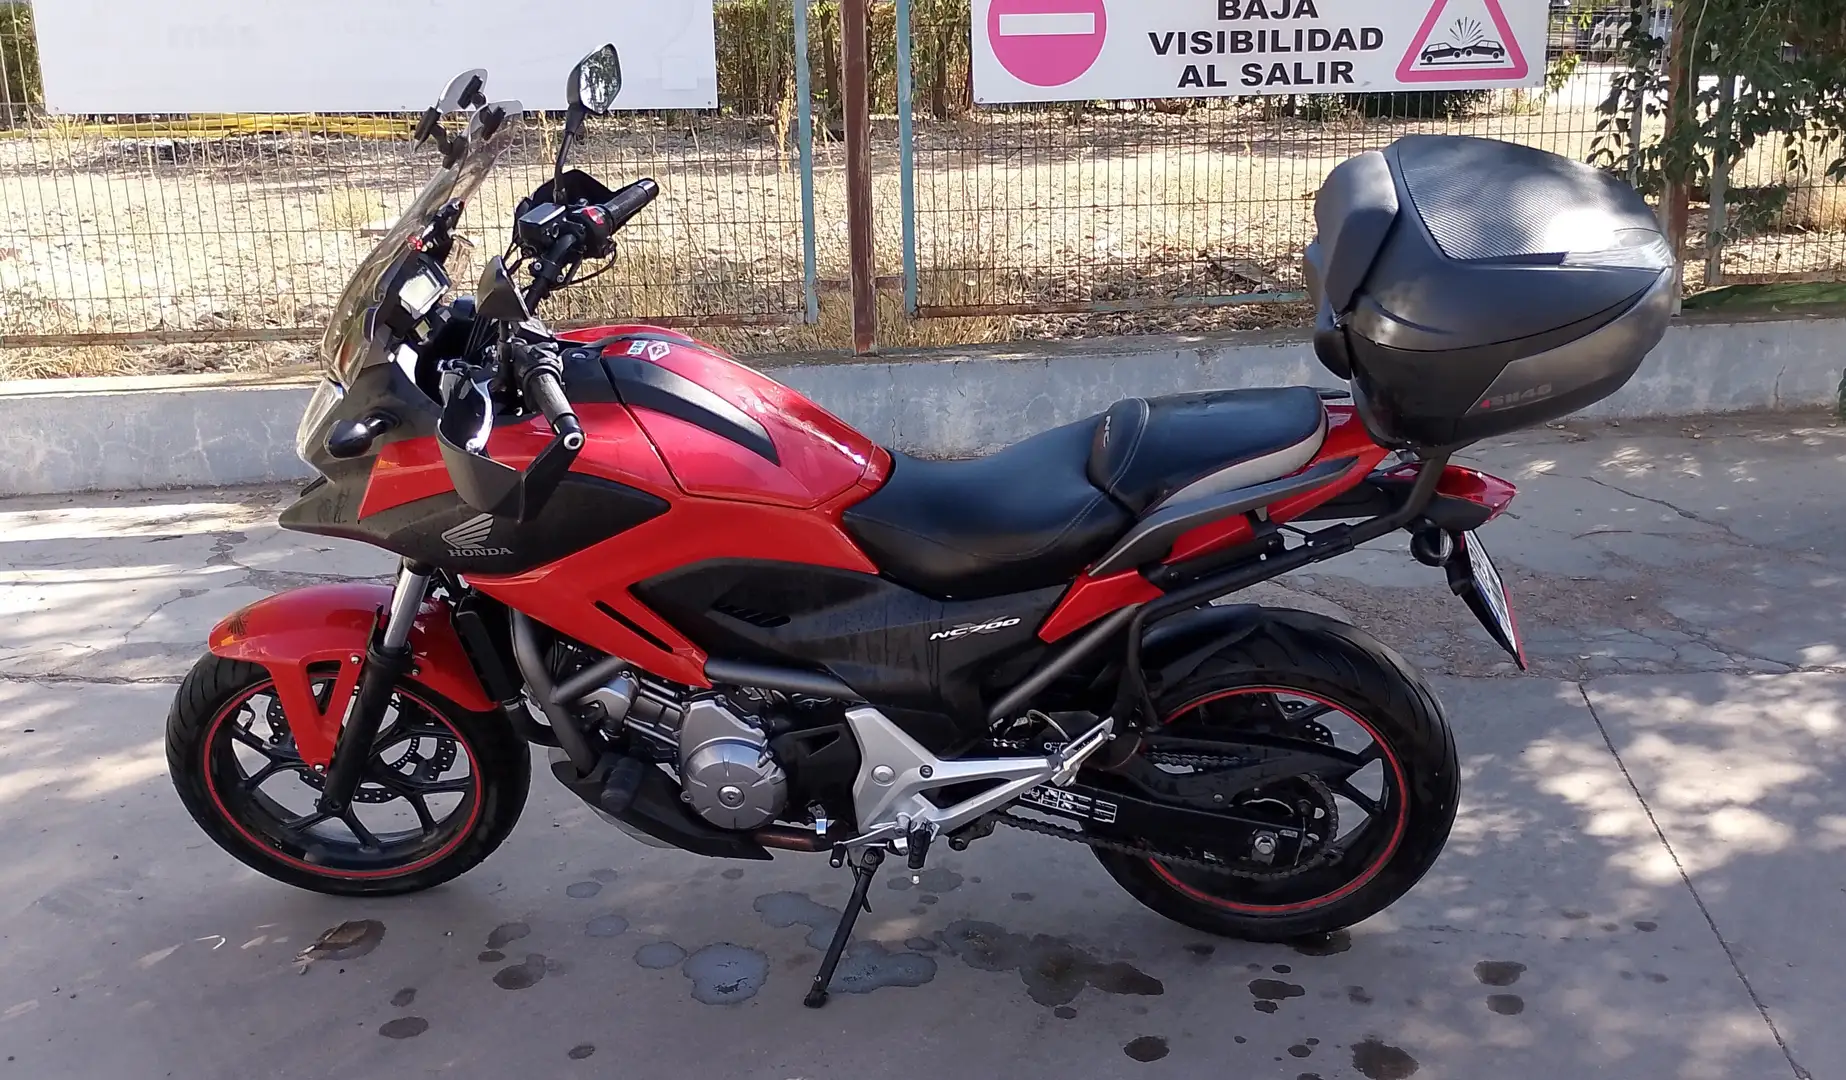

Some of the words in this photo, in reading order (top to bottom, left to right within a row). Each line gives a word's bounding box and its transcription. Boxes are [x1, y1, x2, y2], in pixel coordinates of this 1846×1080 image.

[1217, 0, 1319, 20] BAJA
[1148, 27, 1384, 56] VISIBILIDAD
[1177, 64, 1227, 88] AL
[1241, 61, 1354, 86] SALIR
[448, 547, 514, 557] HONDA
